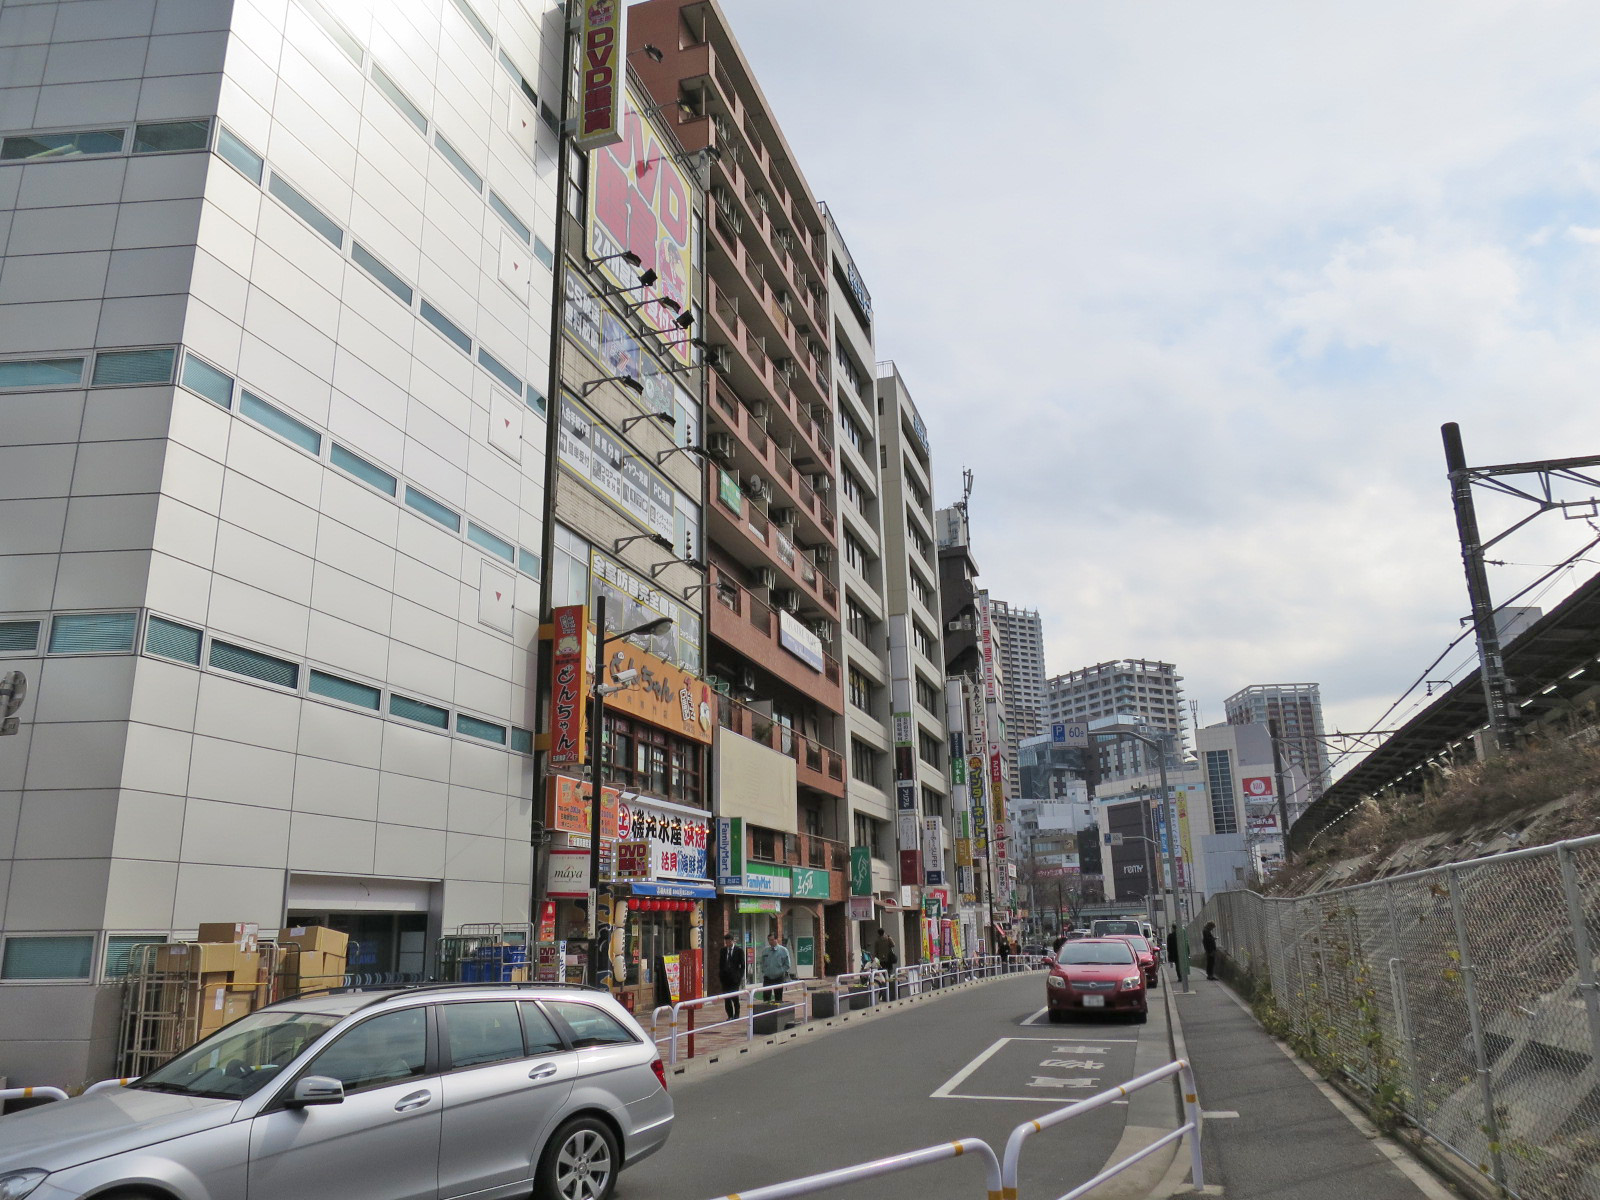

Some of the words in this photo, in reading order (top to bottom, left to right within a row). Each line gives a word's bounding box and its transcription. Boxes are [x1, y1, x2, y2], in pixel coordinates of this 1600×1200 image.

[584, 26, 614, 135] DVD
[1056, 726, 1063, 737] P
[970, 769, 986, 836] インターネット
[618, 843, 647, 858] DVD
[721, 822, 730, 872] FamilyMart
[746, 874, 772, 891] FamilyMart
[539, 947, 556, 956] DVD
